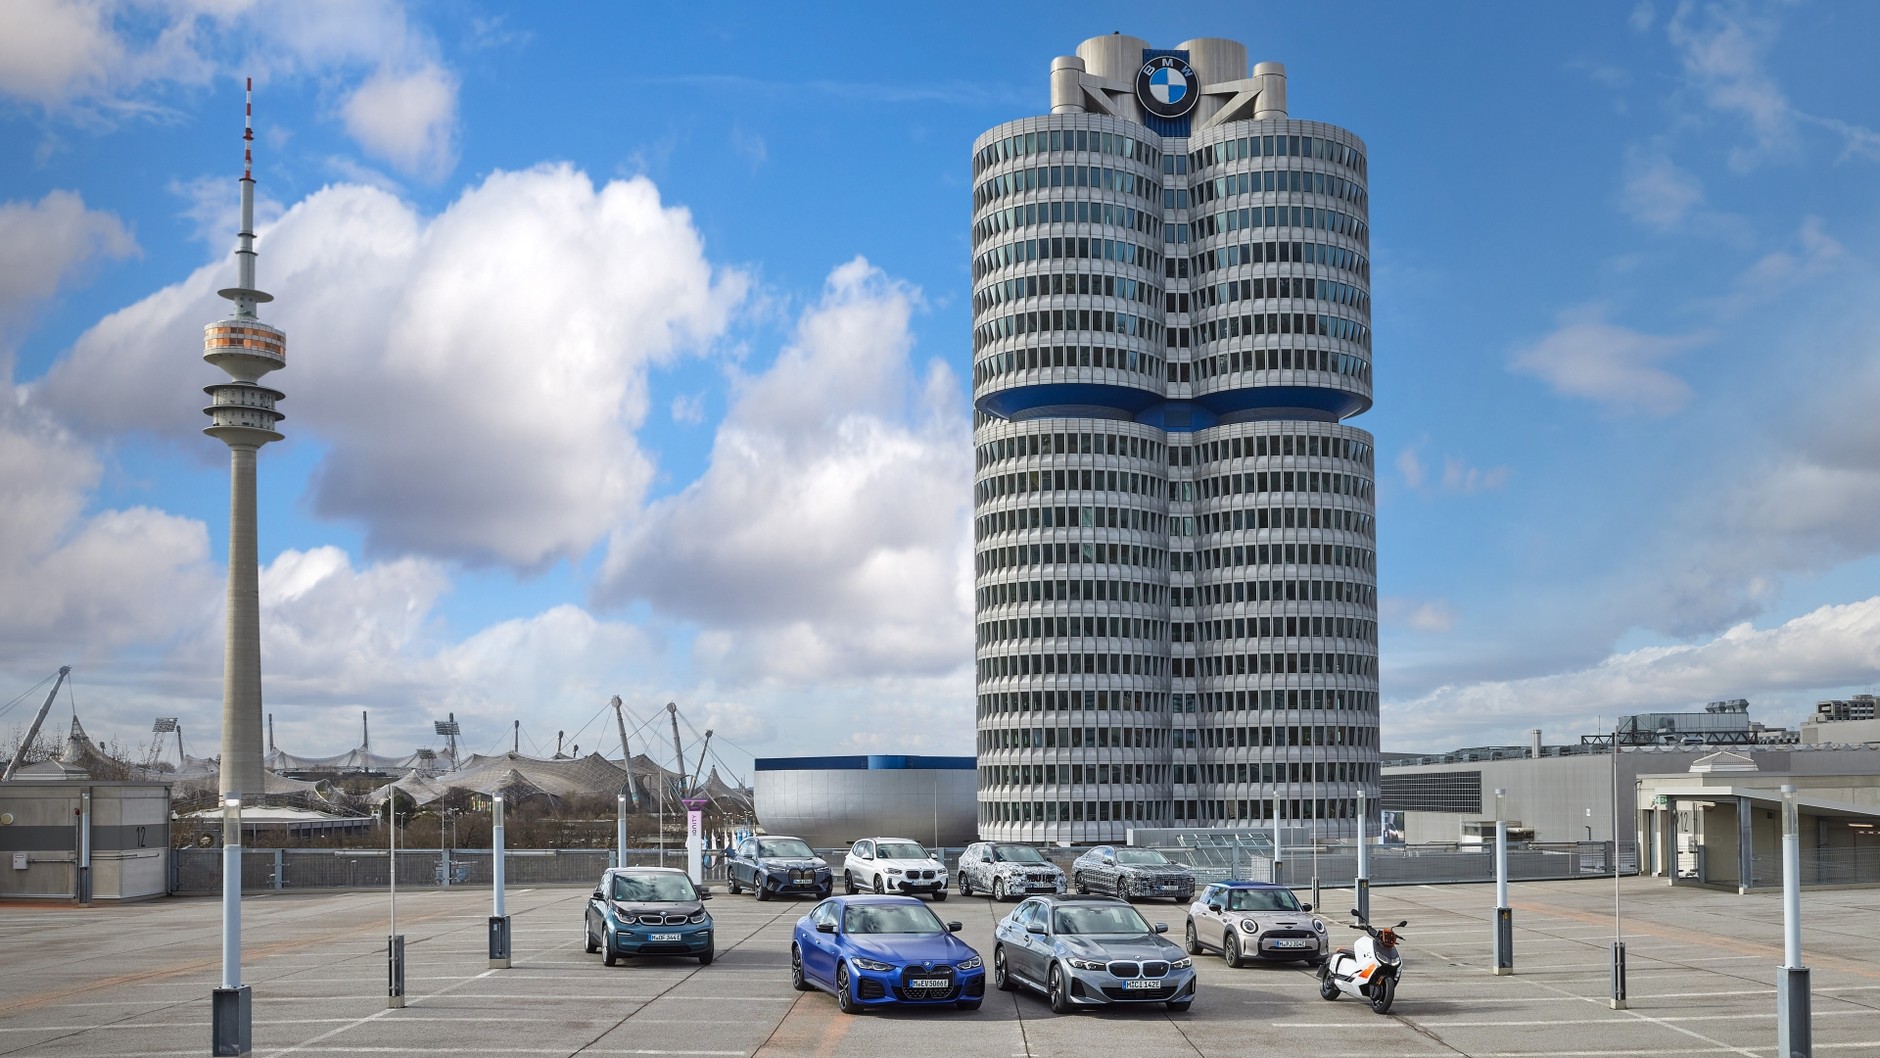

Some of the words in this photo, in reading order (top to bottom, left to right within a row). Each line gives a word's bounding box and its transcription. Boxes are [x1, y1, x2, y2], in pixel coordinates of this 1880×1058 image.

[1143, 58, 1193, 77] BMW
[1680, 811, 1689, 832] 12
[136, 826, 146, 848] 12
